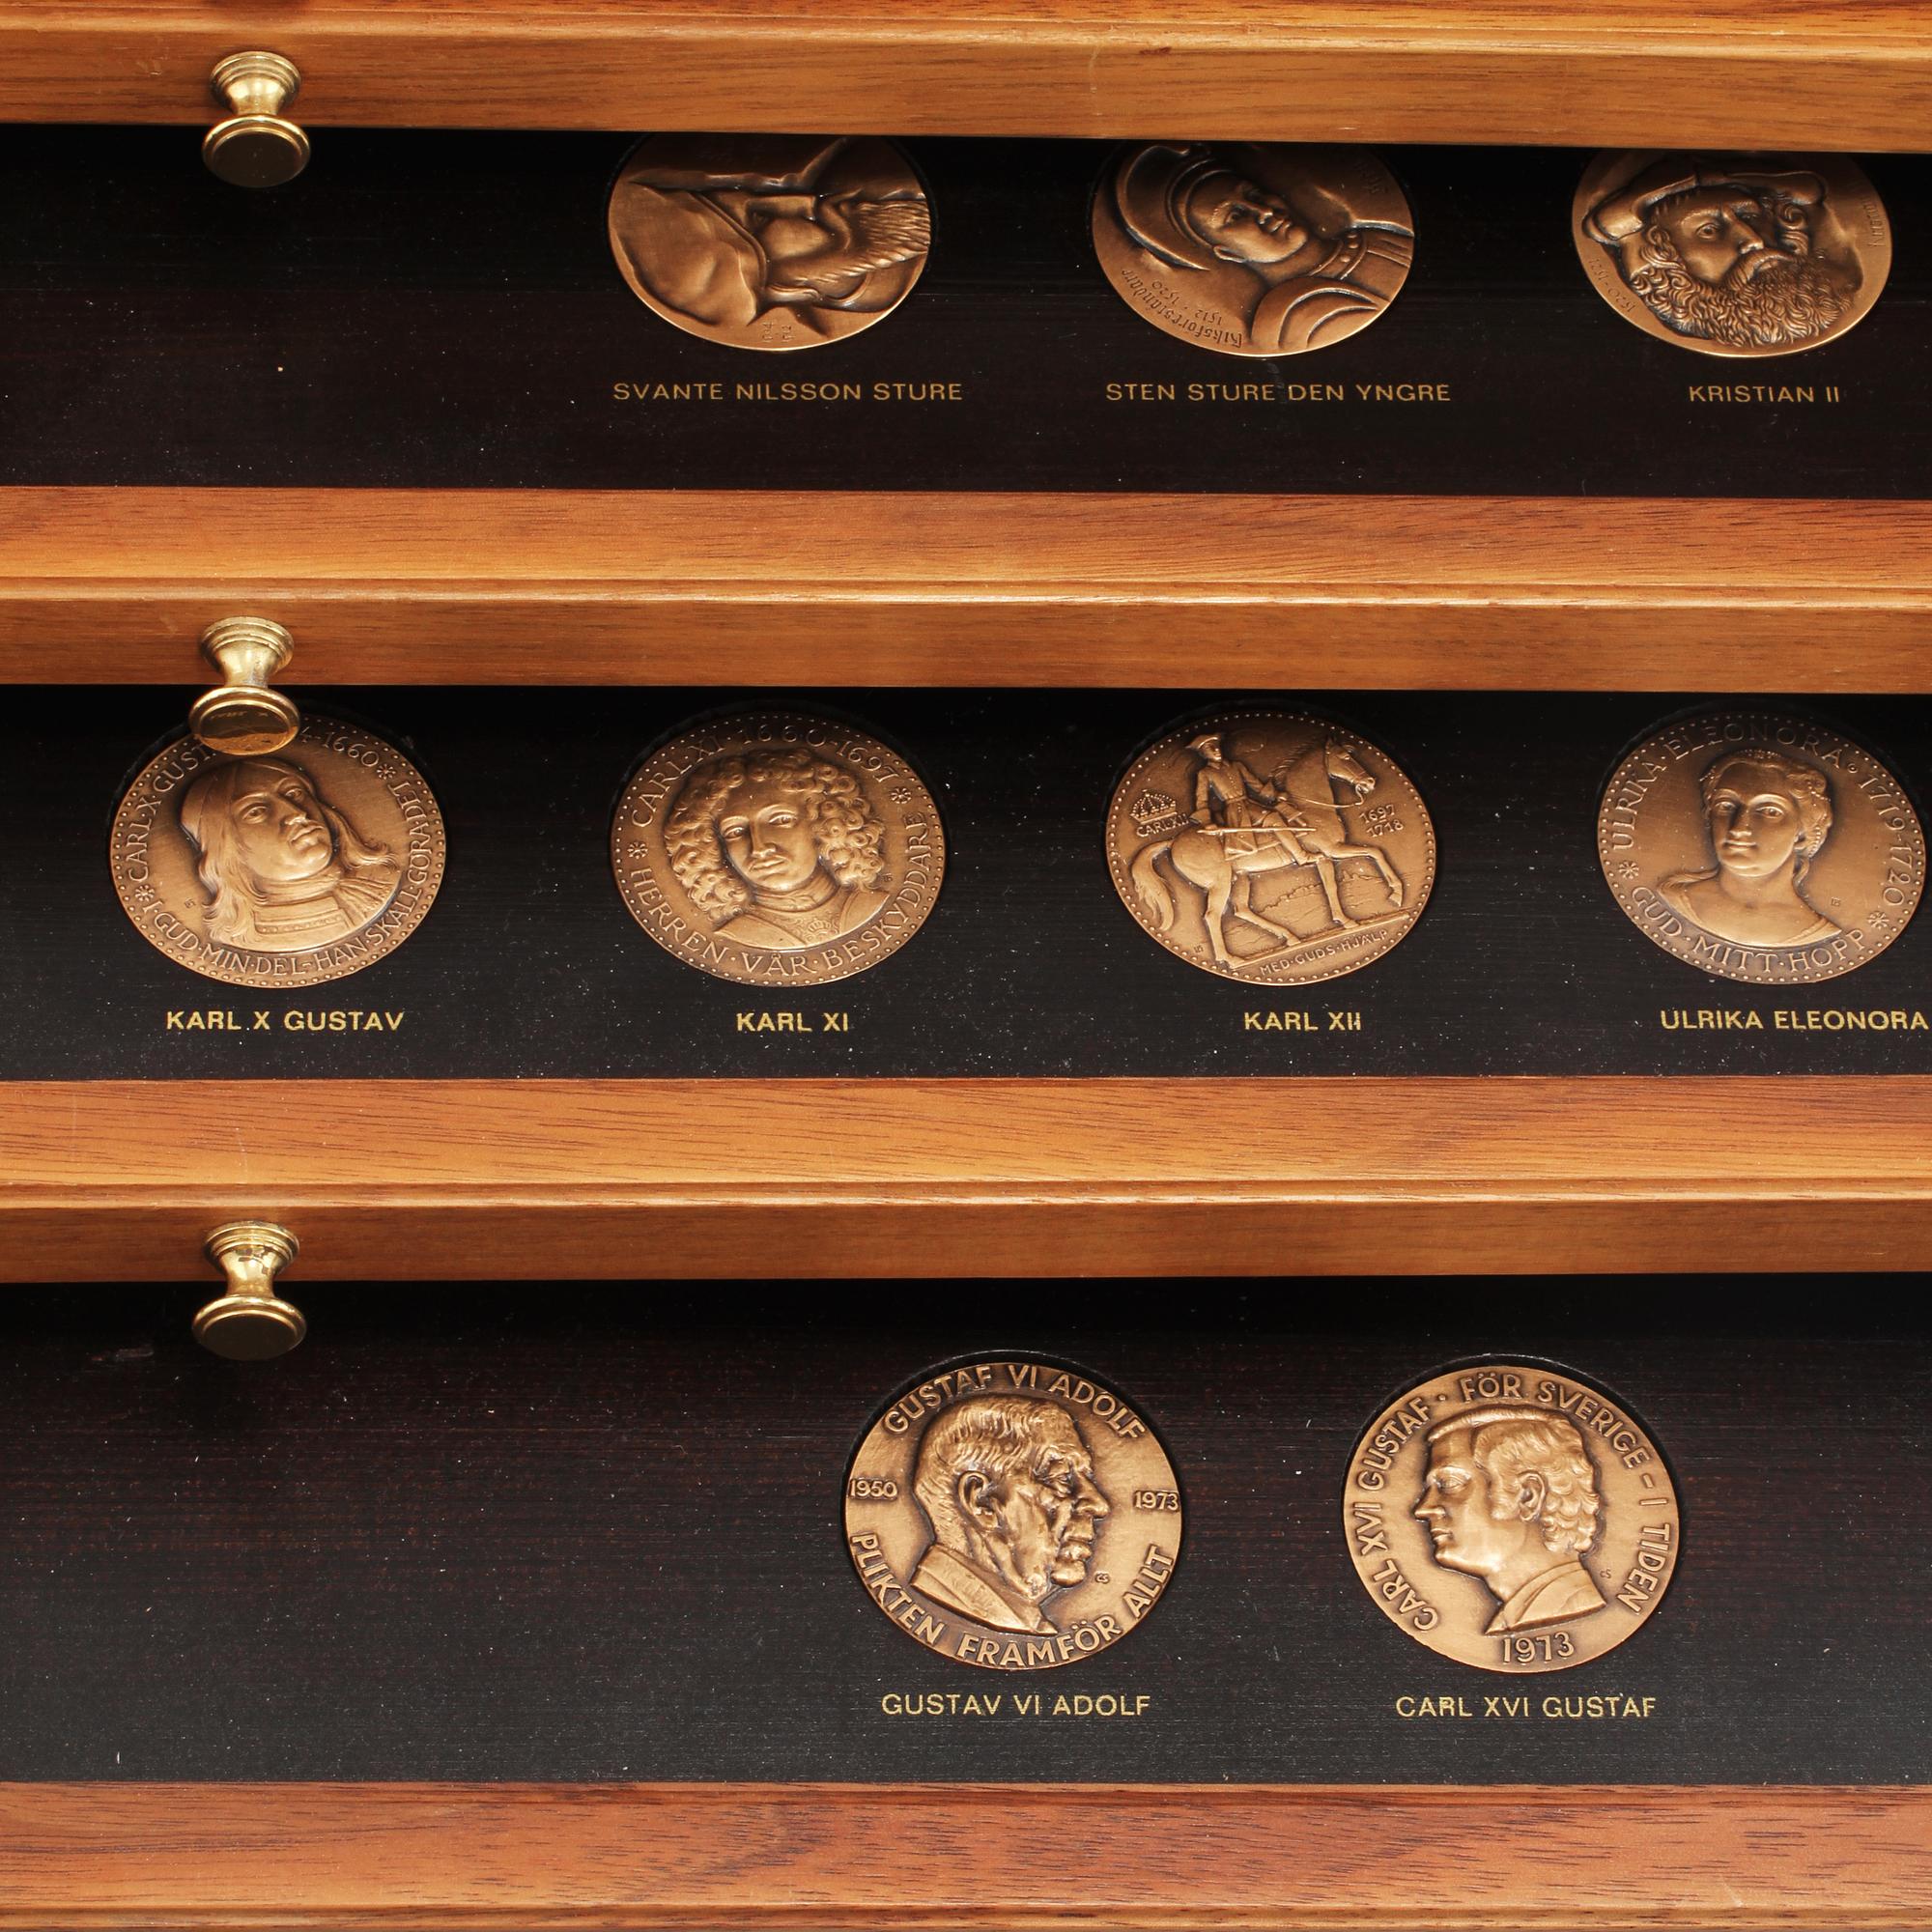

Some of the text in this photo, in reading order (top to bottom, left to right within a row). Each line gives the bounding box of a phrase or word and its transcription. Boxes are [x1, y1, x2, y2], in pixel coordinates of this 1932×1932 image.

[613, 383, 962, 401] SVANTE NILSSON STURE
[1106, 384, 1451, 402] STEN STURE DEN YNGRE
[1689, 385, 1840, 403] KRISTIAN II
[135, 796, 162, 816] X
[387, 781, 428, 822] DET
[631, 760, 693, 828] CARL
[1611, 762, 1668, 851] ULRIKA
[1358, 804, 1396, 824] 1697
[1365, 819, 1405, 838] 1718
[125, 817, 153, 883] CARL
[630, 867, 730, 965] HERREN
[820, 811, 934, 971] BESKYDDARE
[155, 912, 200, 951] GUD
[365, 888, 423, 947] SKALL
[1632, 887, 1865, 973] GUD MITT HOPP
[198, 943, 250, 975] MIN
[1259, 958, 1292, 977] MED
[1294, 944, 1337, 965] GUDS
[166, 1010, 404, 1031] KARL X GUSTAV
[736, 1011, 849, 1033] KARL XI
[1243, 1011, 1362, 1032] KARL XII
[1660, 1009, 1930, 1031] ULRIKA ELEONORA
[884, 1363, 1149, 1440] GUSTAF VI ADOLF
[1459, 1371, 1523, 1403] FÖR
[1536, 1379, 1651, 1470] SVERIGE
[1355, 1395, 1433, 1492] GUSTAF
[849, 1478, 899, 1499] 1950
[1133, 1490, 1180, 1512] 1973
[1353, 1501, 1389, 1556] XVI
[1615, 1522, 1672, 1615] TIDEN
[850, 1531, 1176, 1667] PLIKTEN FRAMFÖR ALLT
[1372, 1556, 1440, 1634] CARL
[1503, 1631, 1576, 1664] 1973
[880, 1692, 1151, 1717] GUSTAV VI ADOLF
[1395, 1695, 1657, 1719] CARL XVI GUSTAF
